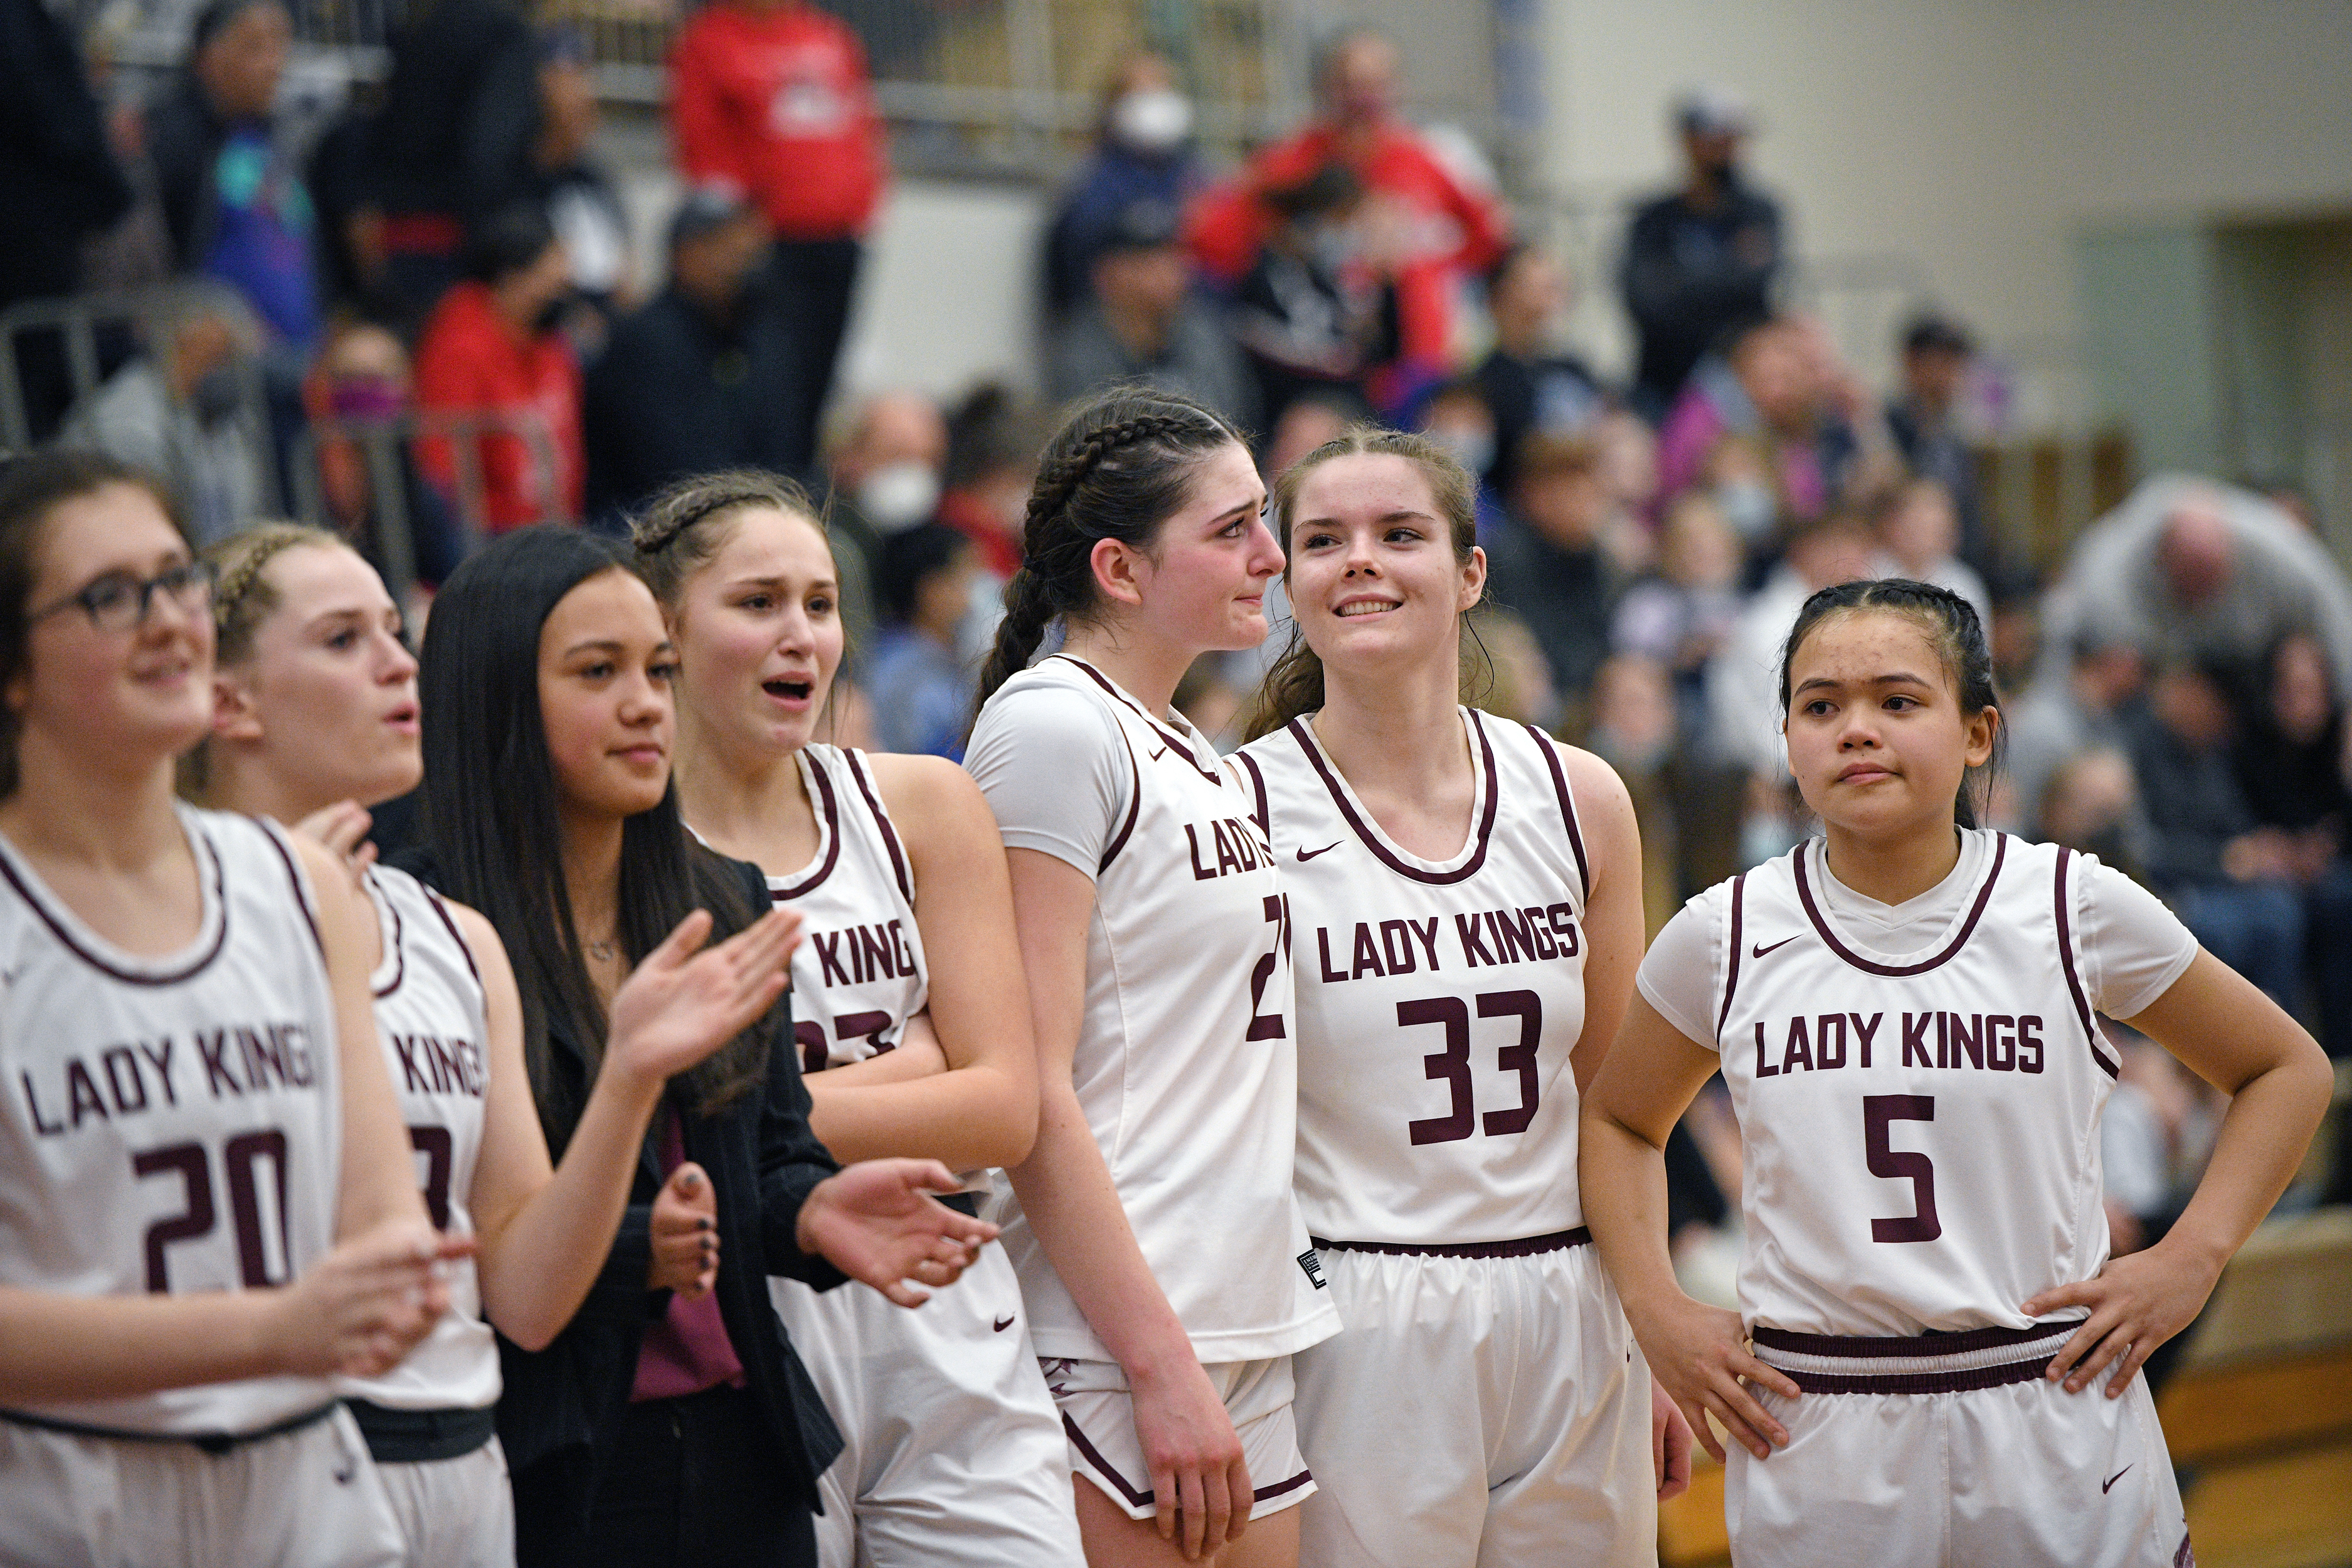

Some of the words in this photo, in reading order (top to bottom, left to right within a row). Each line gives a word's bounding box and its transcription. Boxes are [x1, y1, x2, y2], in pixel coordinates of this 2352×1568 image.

[1316, 916, 1439, 983] LADY
[1454, 902, 1579, 968] KINGS
[21, 1034, 178, 1136] LADY
[1396, 988, 1543, 1146] 33
[1754, 1012, 1884, 1079] LADY
[1902, 1011, 2044, 1074] KINGS
[131, 1129, 292, 1297] 20
[1862, 1094, 1942, 1243] 5
